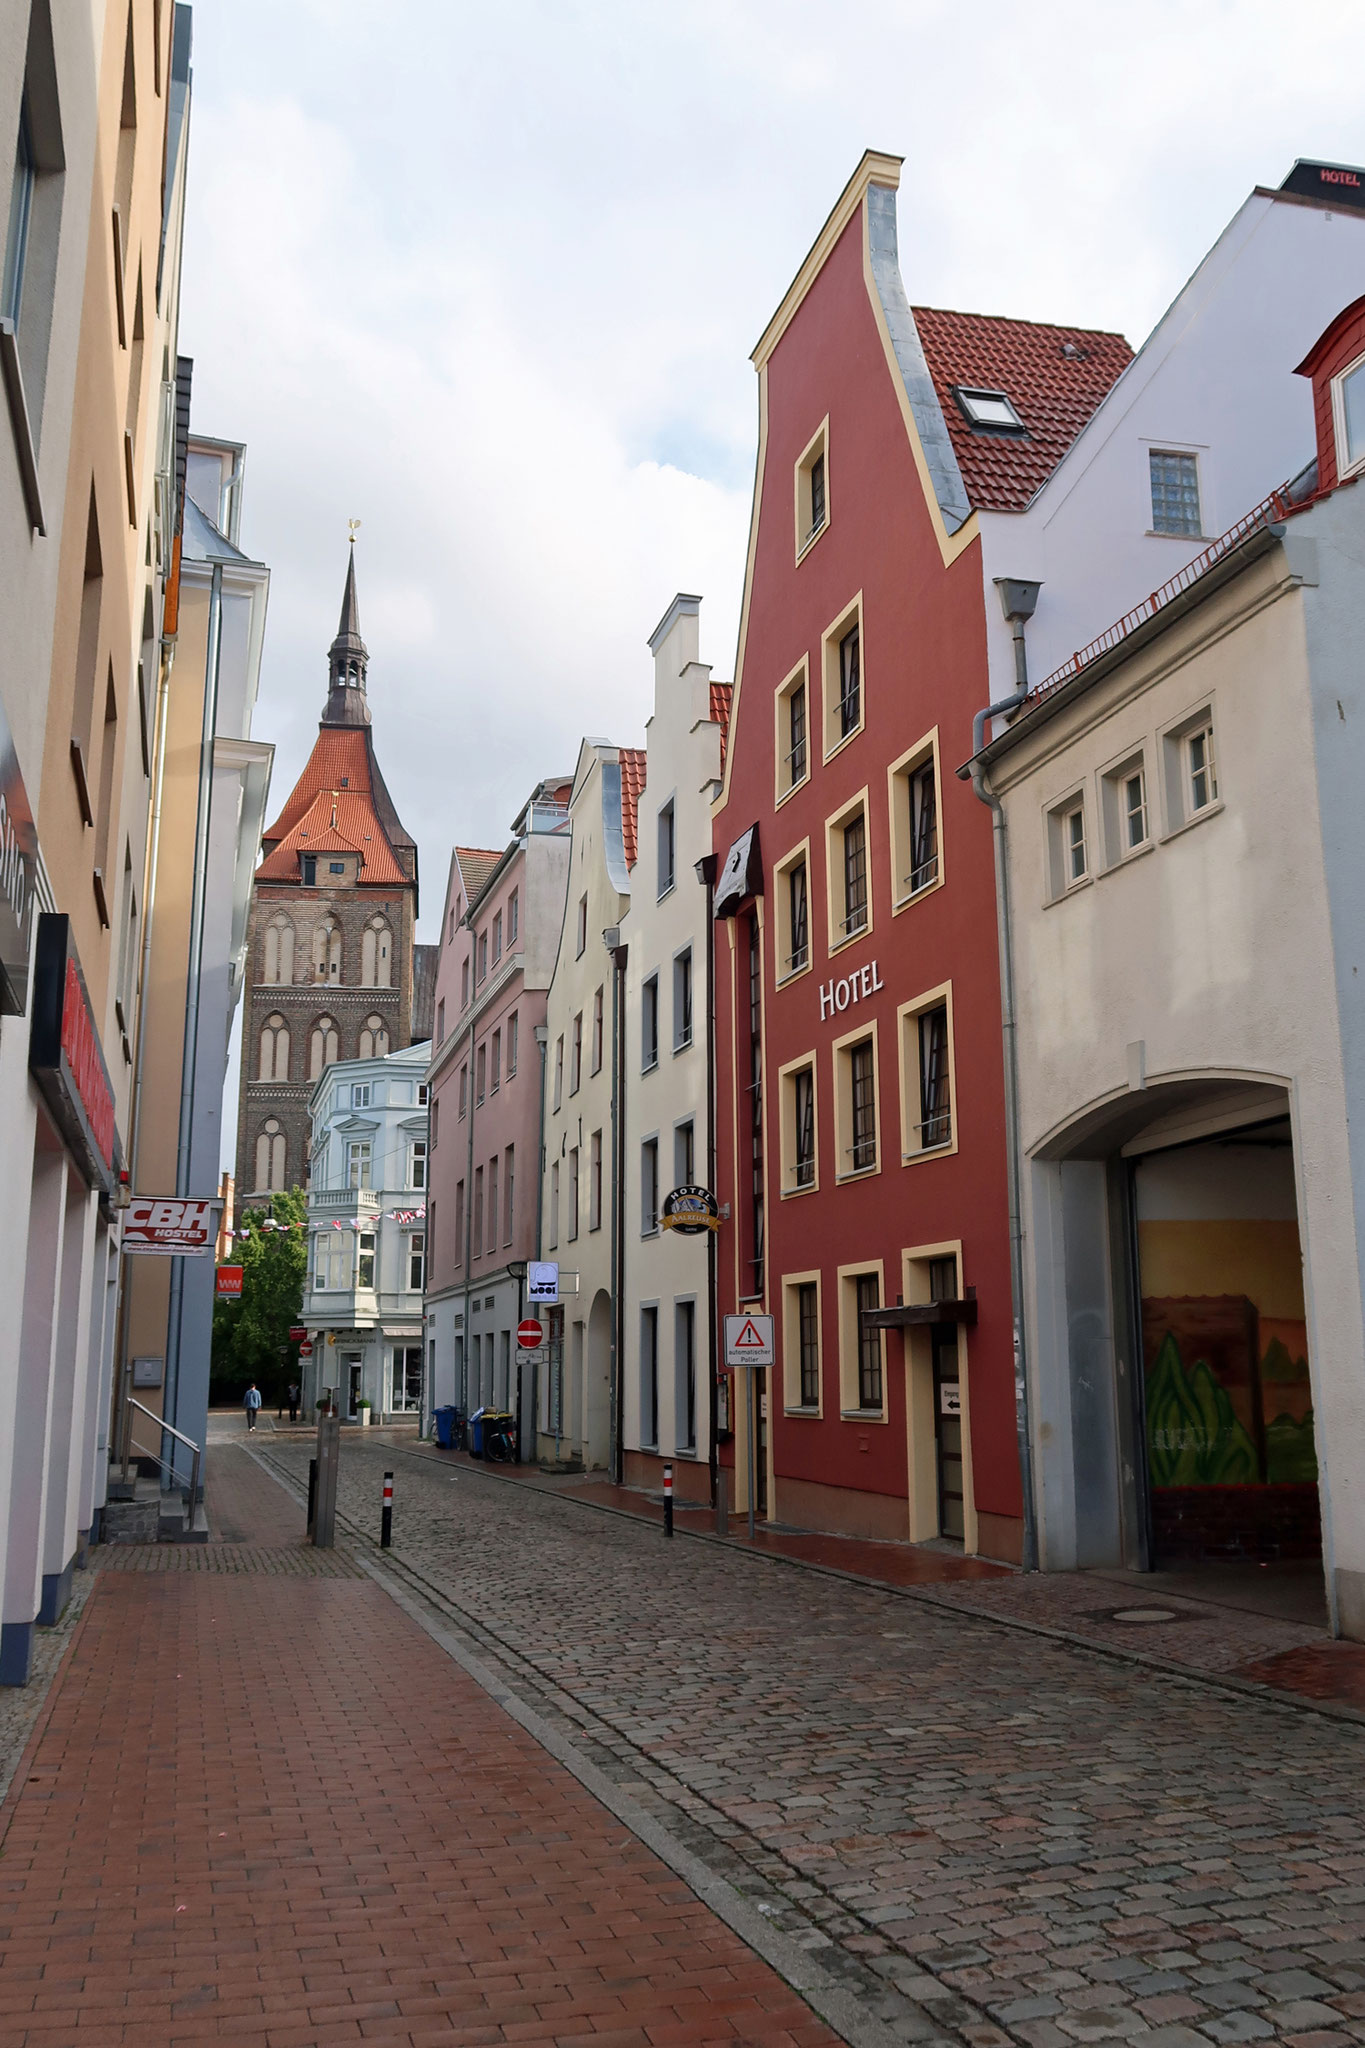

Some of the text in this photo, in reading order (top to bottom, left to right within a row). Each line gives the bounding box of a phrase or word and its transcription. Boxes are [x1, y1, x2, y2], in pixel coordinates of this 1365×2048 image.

[1320, 168, 1361, 187] HOTEL
[819, 959, 884, 1022] HOTEL
[670, 1187, 709, 1201] HOTEL
[125, 1200, 209, 1229] CBH
[154, 1229, 202, 1238] HOSTEL
